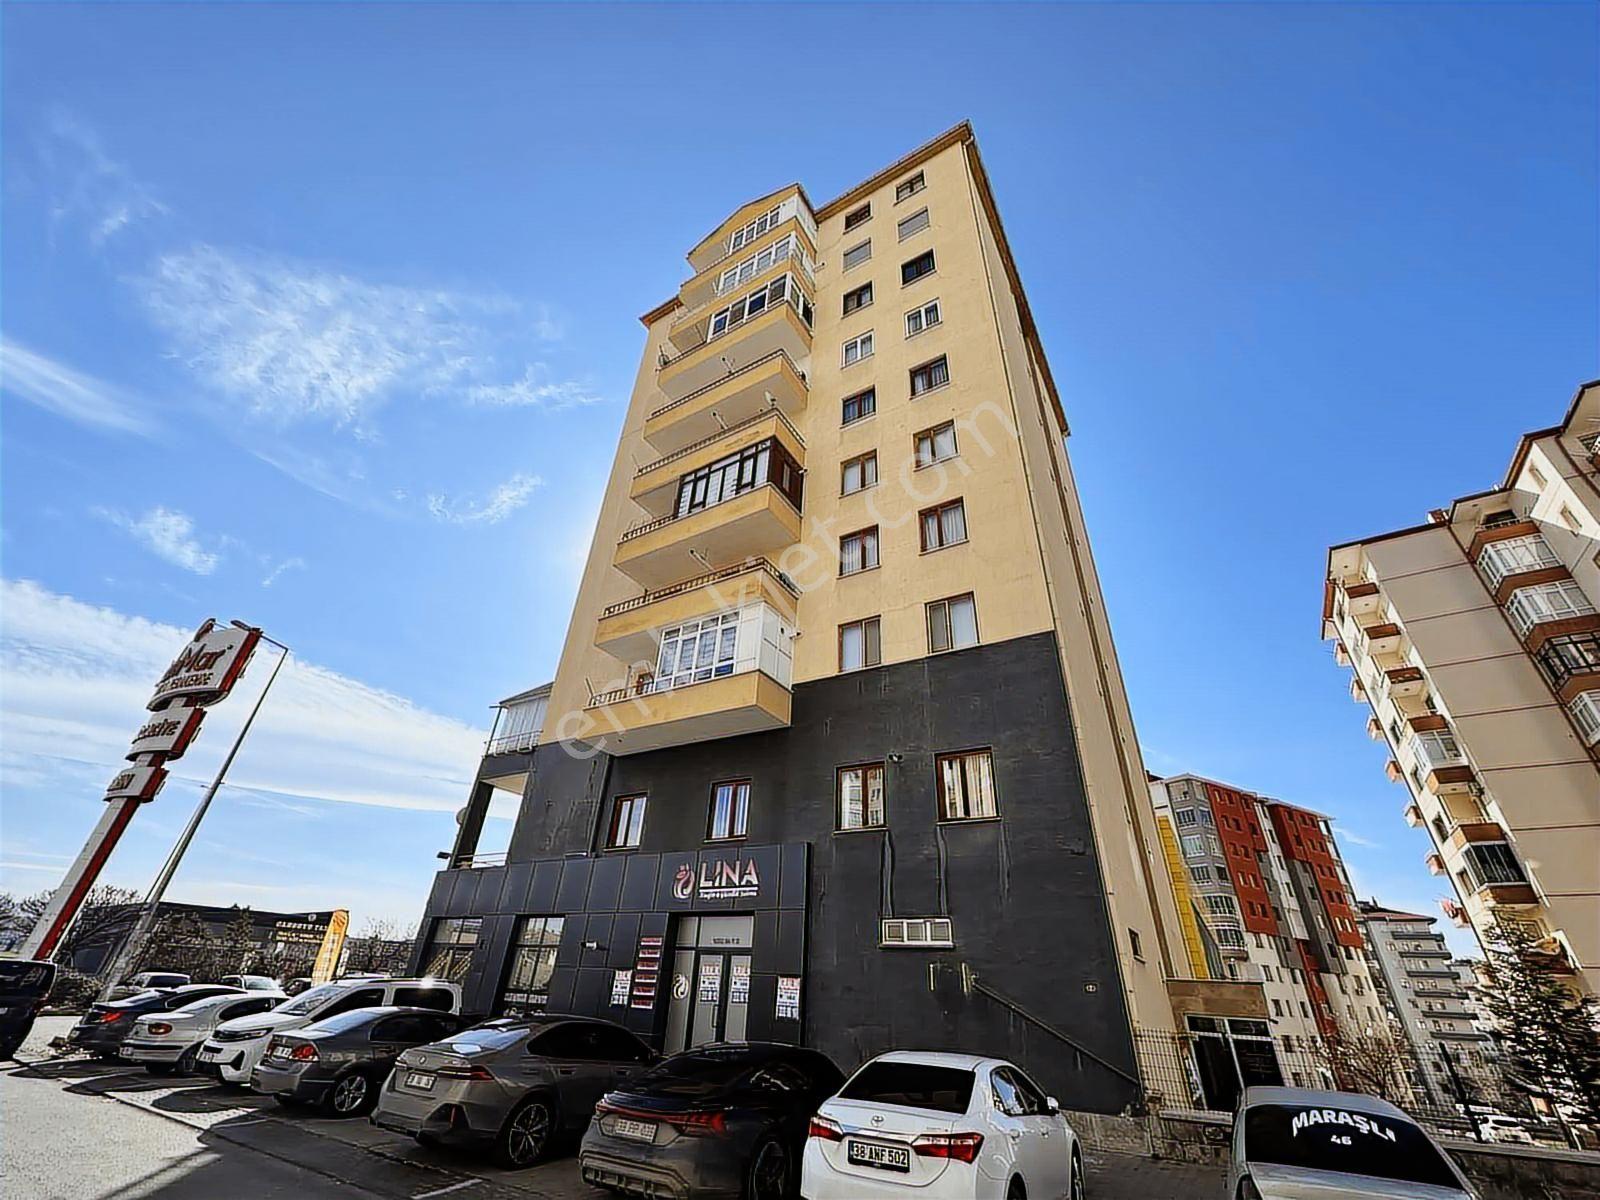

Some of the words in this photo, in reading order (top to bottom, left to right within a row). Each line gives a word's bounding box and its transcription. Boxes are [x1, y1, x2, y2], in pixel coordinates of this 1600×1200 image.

[1330, 1134, 1352, 1145] 46
[853, 1144, 866, 1159] 38
[888, 1149, 907, 1166] 502
